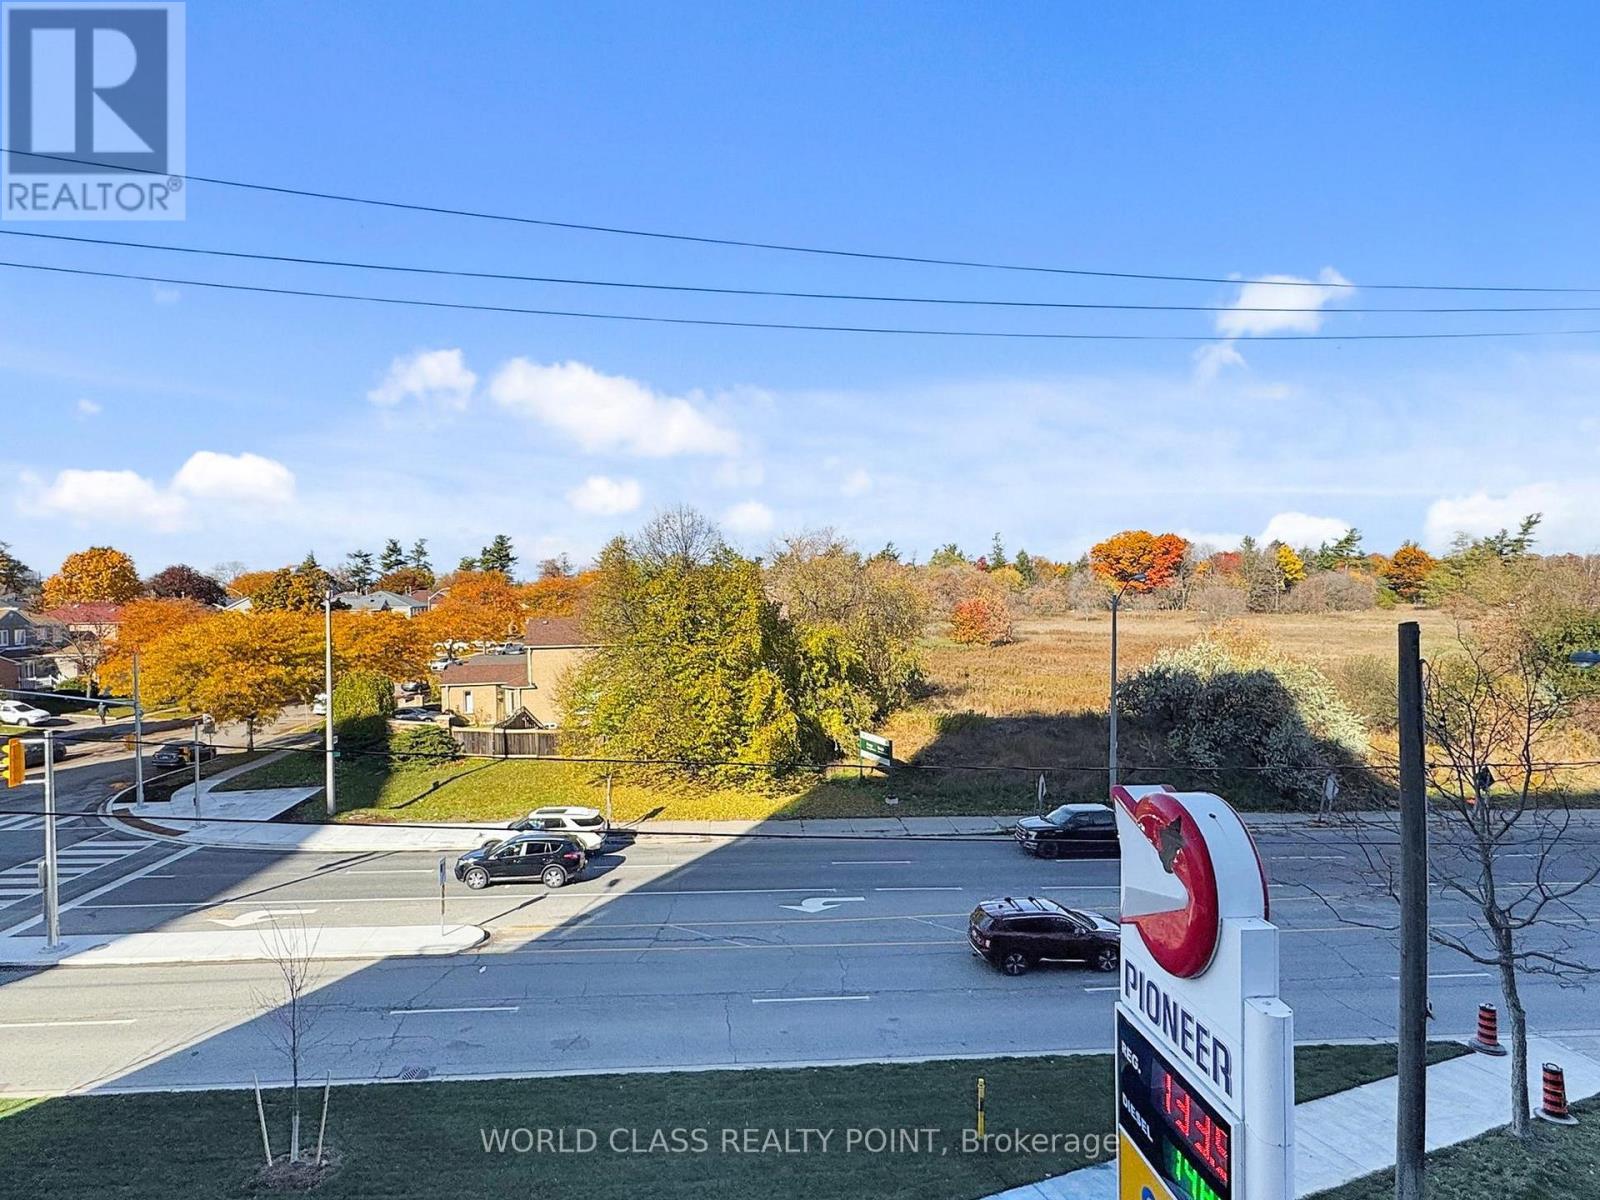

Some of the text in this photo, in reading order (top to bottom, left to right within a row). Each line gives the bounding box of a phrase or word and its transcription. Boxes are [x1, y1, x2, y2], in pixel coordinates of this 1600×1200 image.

[1125, 959, 1232, 1098] PIONEER
[1121, 1040, 1141, 1074] REG.
[1121, 1091, 1153, 1143] DIESEL
